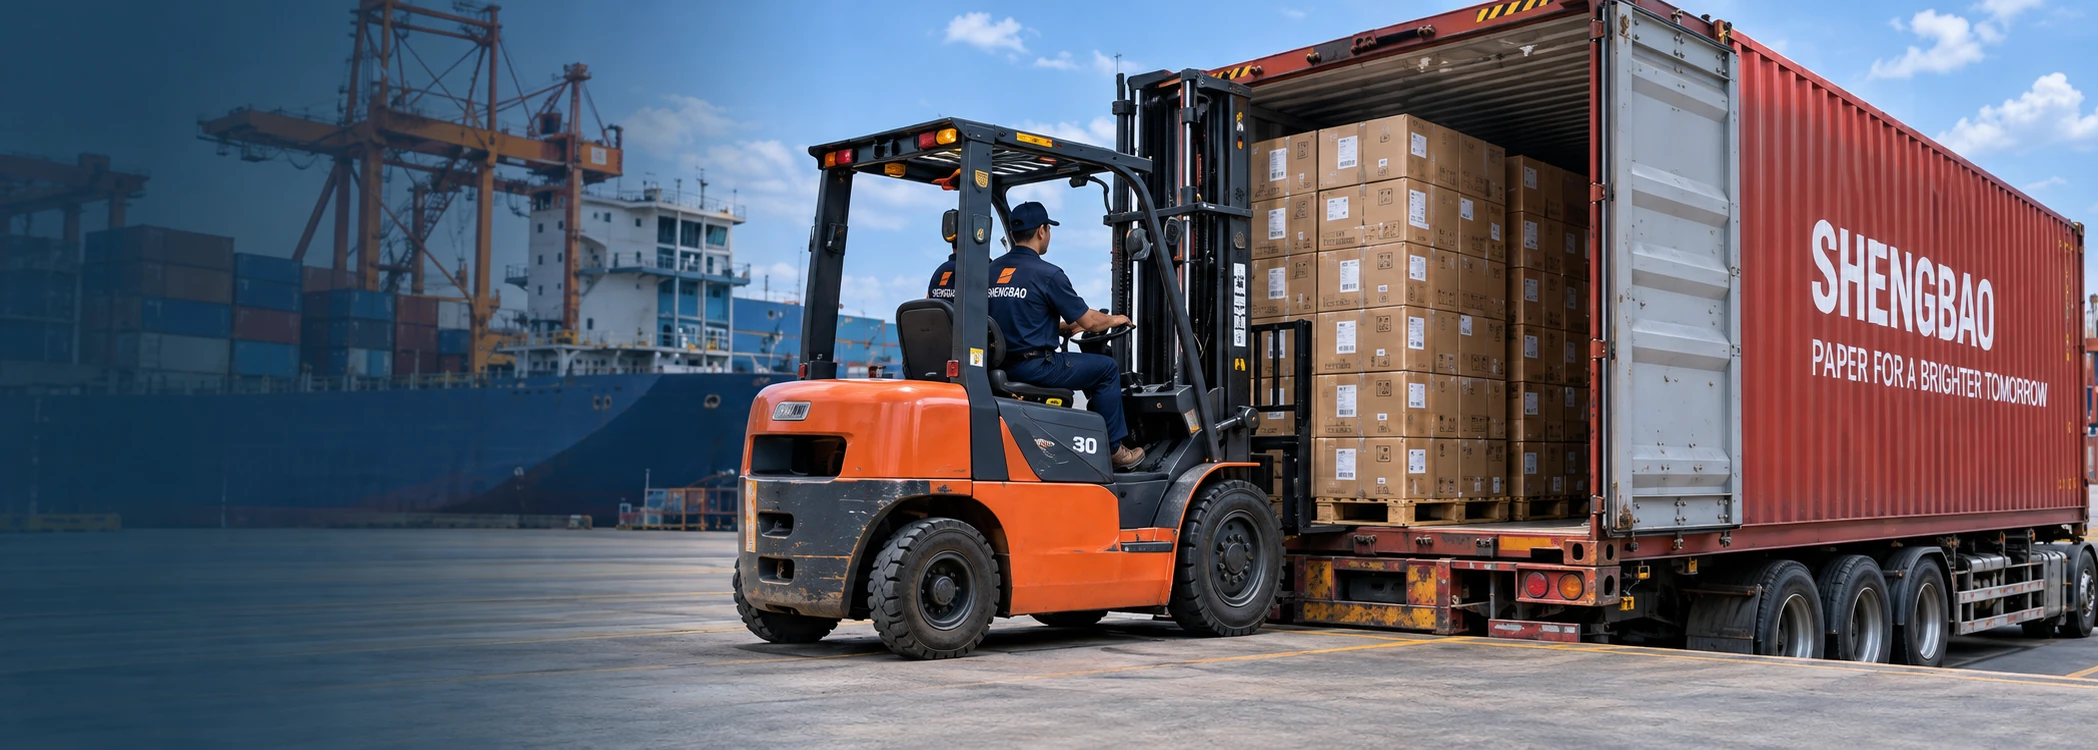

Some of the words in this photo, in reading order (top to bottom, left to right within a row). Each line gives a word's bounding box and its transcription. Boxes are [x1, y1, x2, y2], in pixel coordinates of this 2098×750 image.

[1811, 219, 1995, 351] SHENGBAO
[1812, 338, 1868, 383] PAPER
[1874, 350, 1904, 388] FOR
[1906, 357, 1917, 390] A
[1920, 359, 1982, 399] BRIGHTER
[1984, 372, 2048, 407] TOMORROW
[1072, 436, 1098, 454] 30
